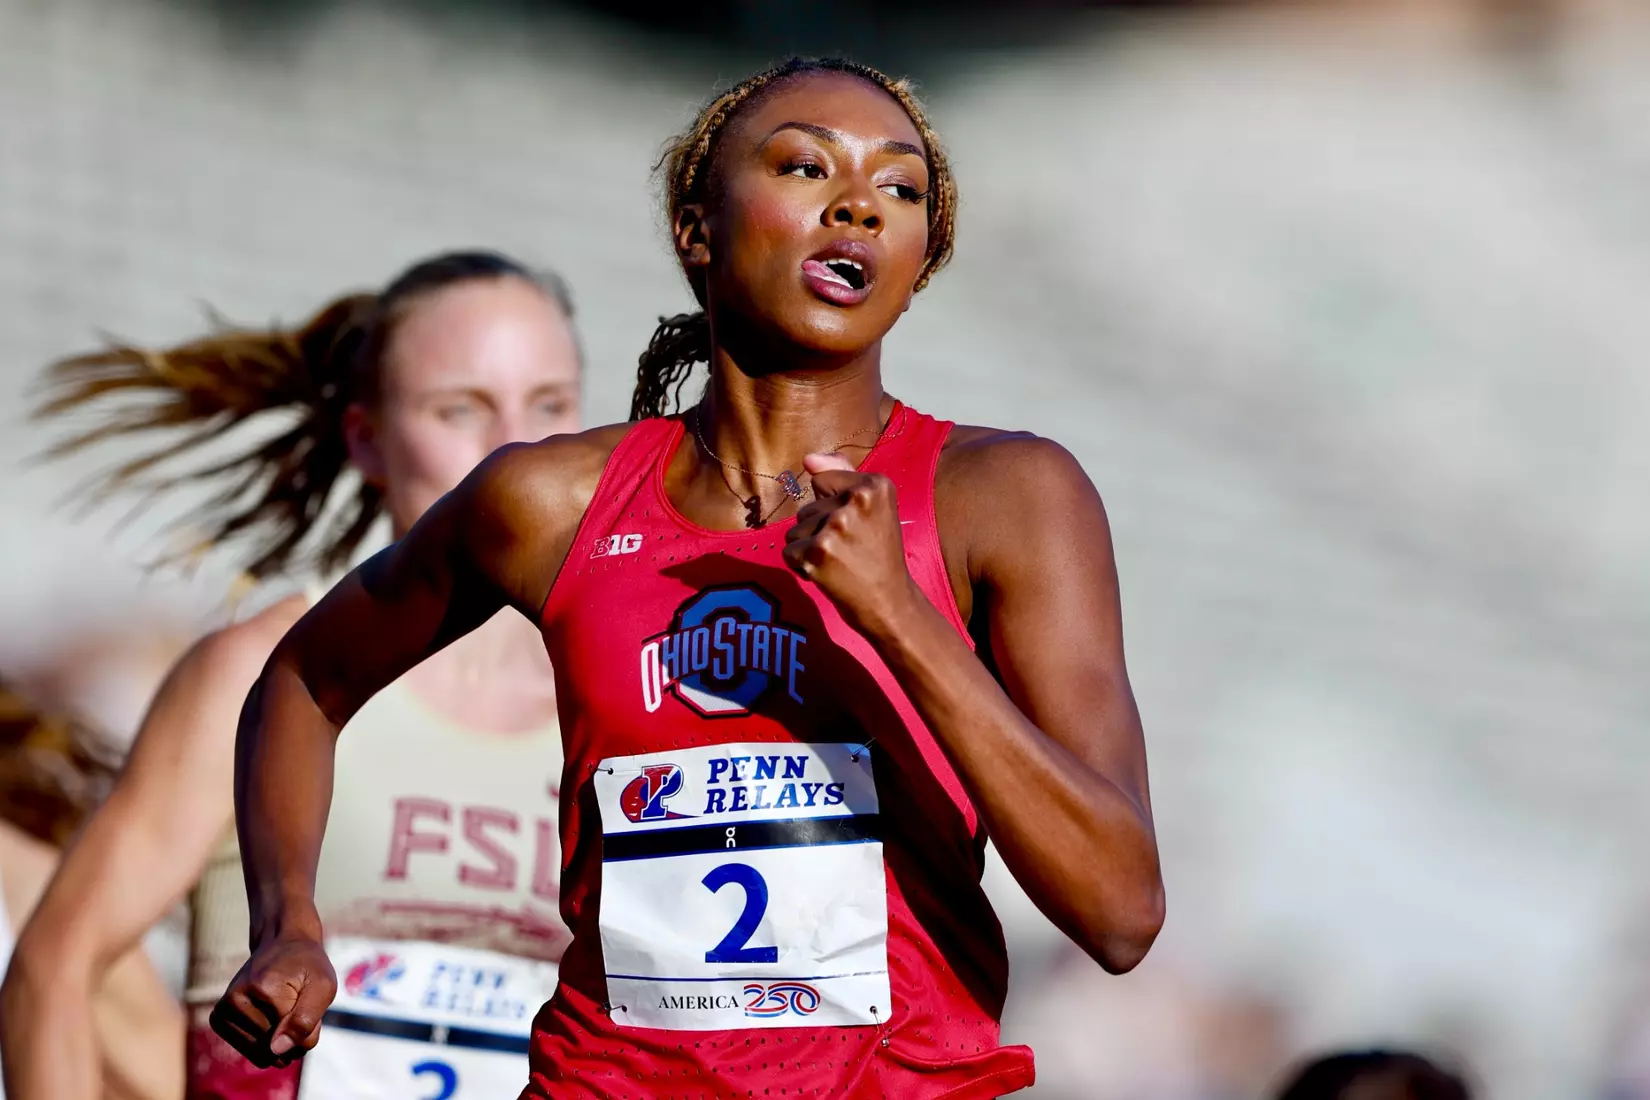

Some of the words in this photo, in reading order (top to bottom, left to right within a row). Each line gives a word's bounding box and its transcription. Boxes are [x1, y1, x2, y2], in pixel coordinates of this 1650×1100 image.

[713, 617, 807, 705] STATE
[706, 755, 809, 785] PENN
[703, 782, 845, 815] RELAYS
[701, 862, 778, 963] 2
[658, 995, 739, 1010] AMERICA
[743, 982, 821, 1018] 250
